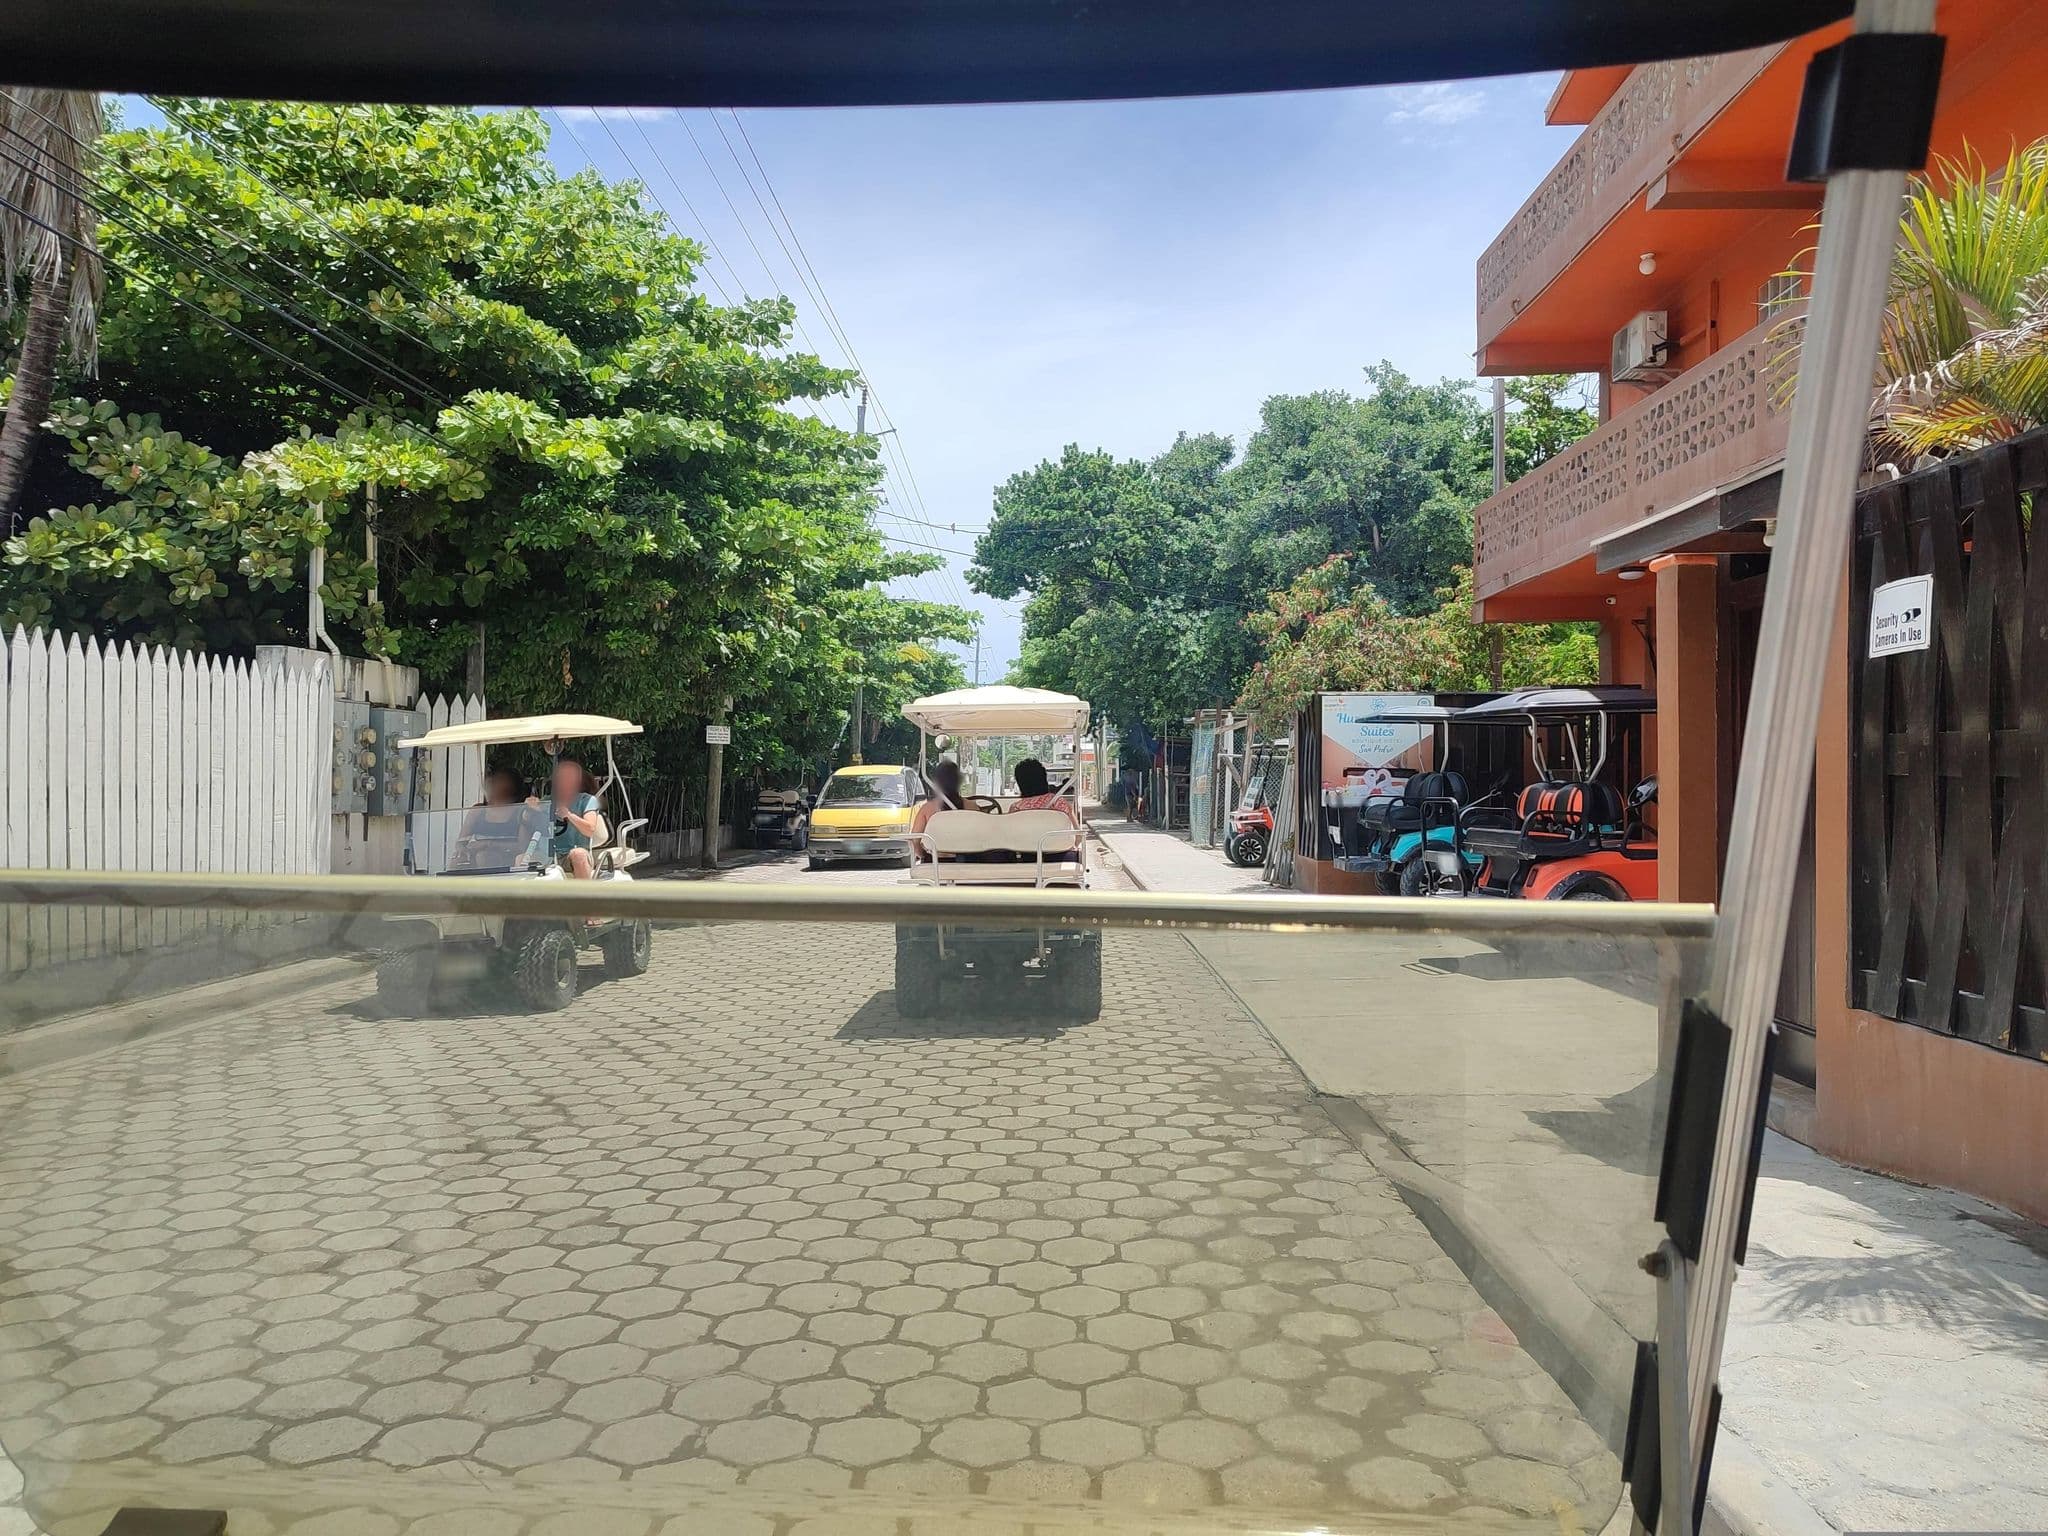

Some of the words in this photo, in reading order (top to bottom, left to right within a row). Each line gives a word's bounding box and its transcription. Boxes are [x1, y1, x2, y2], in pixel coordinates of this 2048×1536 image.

[1876, 612, 1898, 630] Security
[1875, 633, 1898, 647] Cameras
[1909, 627, 1921, 641] Use
[1360, 726, 1394, 737] Suites
